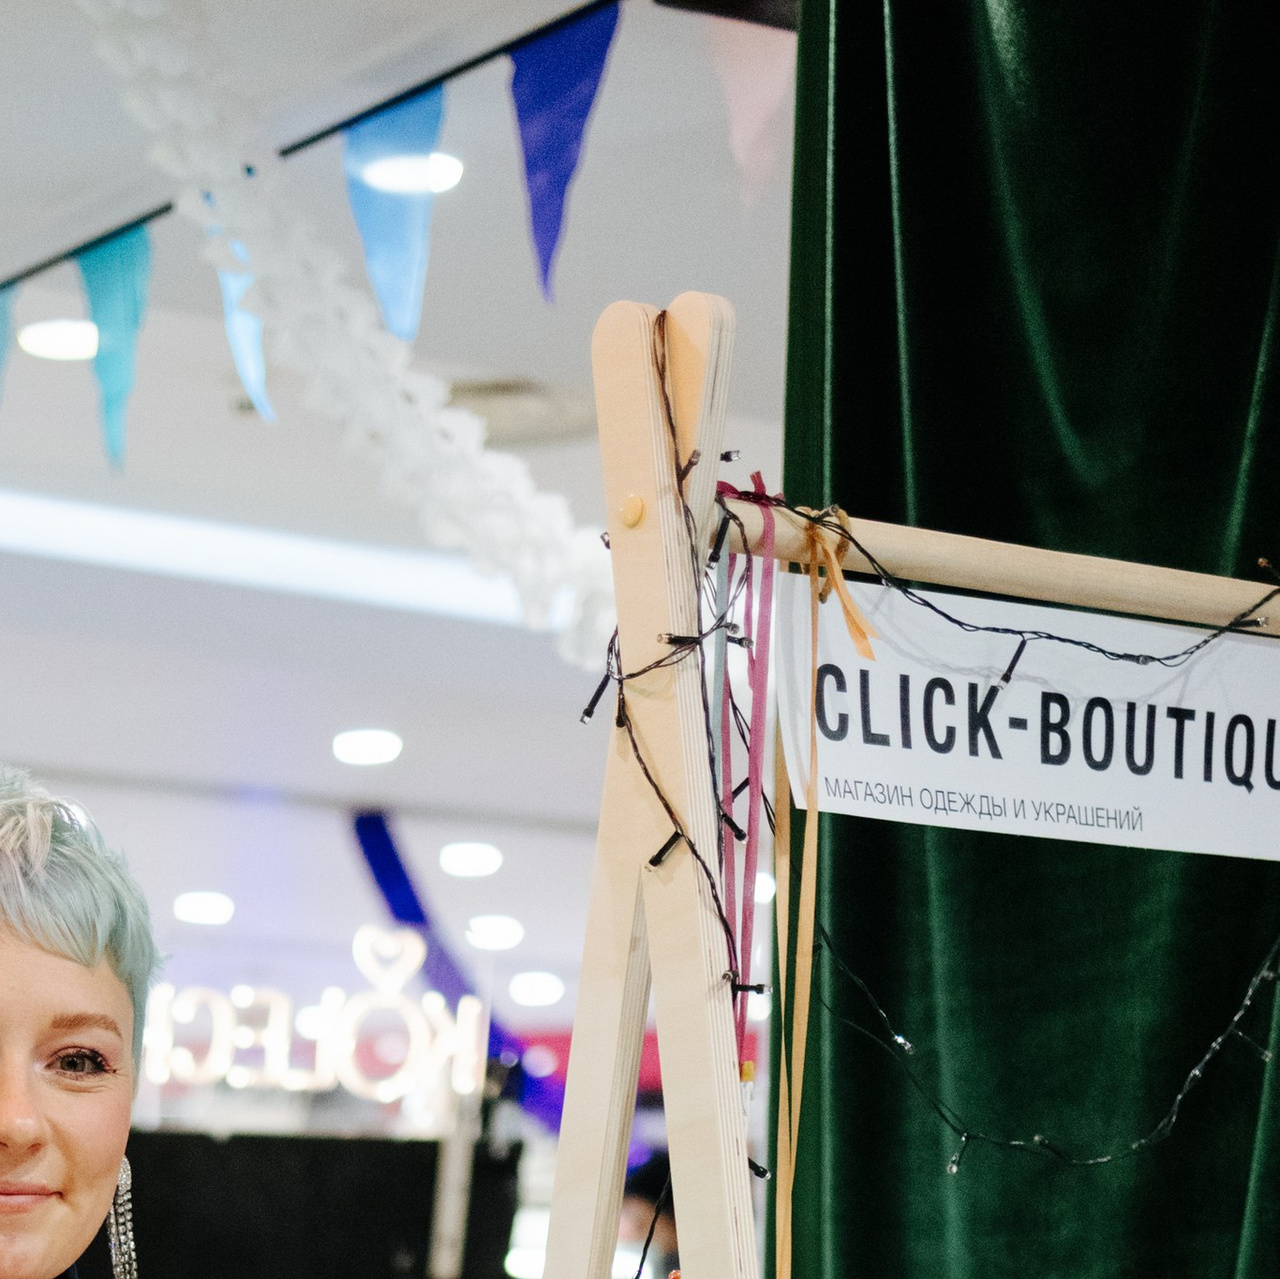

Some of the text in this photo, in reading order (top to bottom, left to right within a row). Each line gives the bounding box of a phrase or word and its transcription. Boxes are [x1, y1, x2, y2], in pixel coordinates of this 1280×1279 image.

[825, 776, 1143, 831] МАГАЗИН ОДЕЖДЫ И УКРАШЕНИЙ
